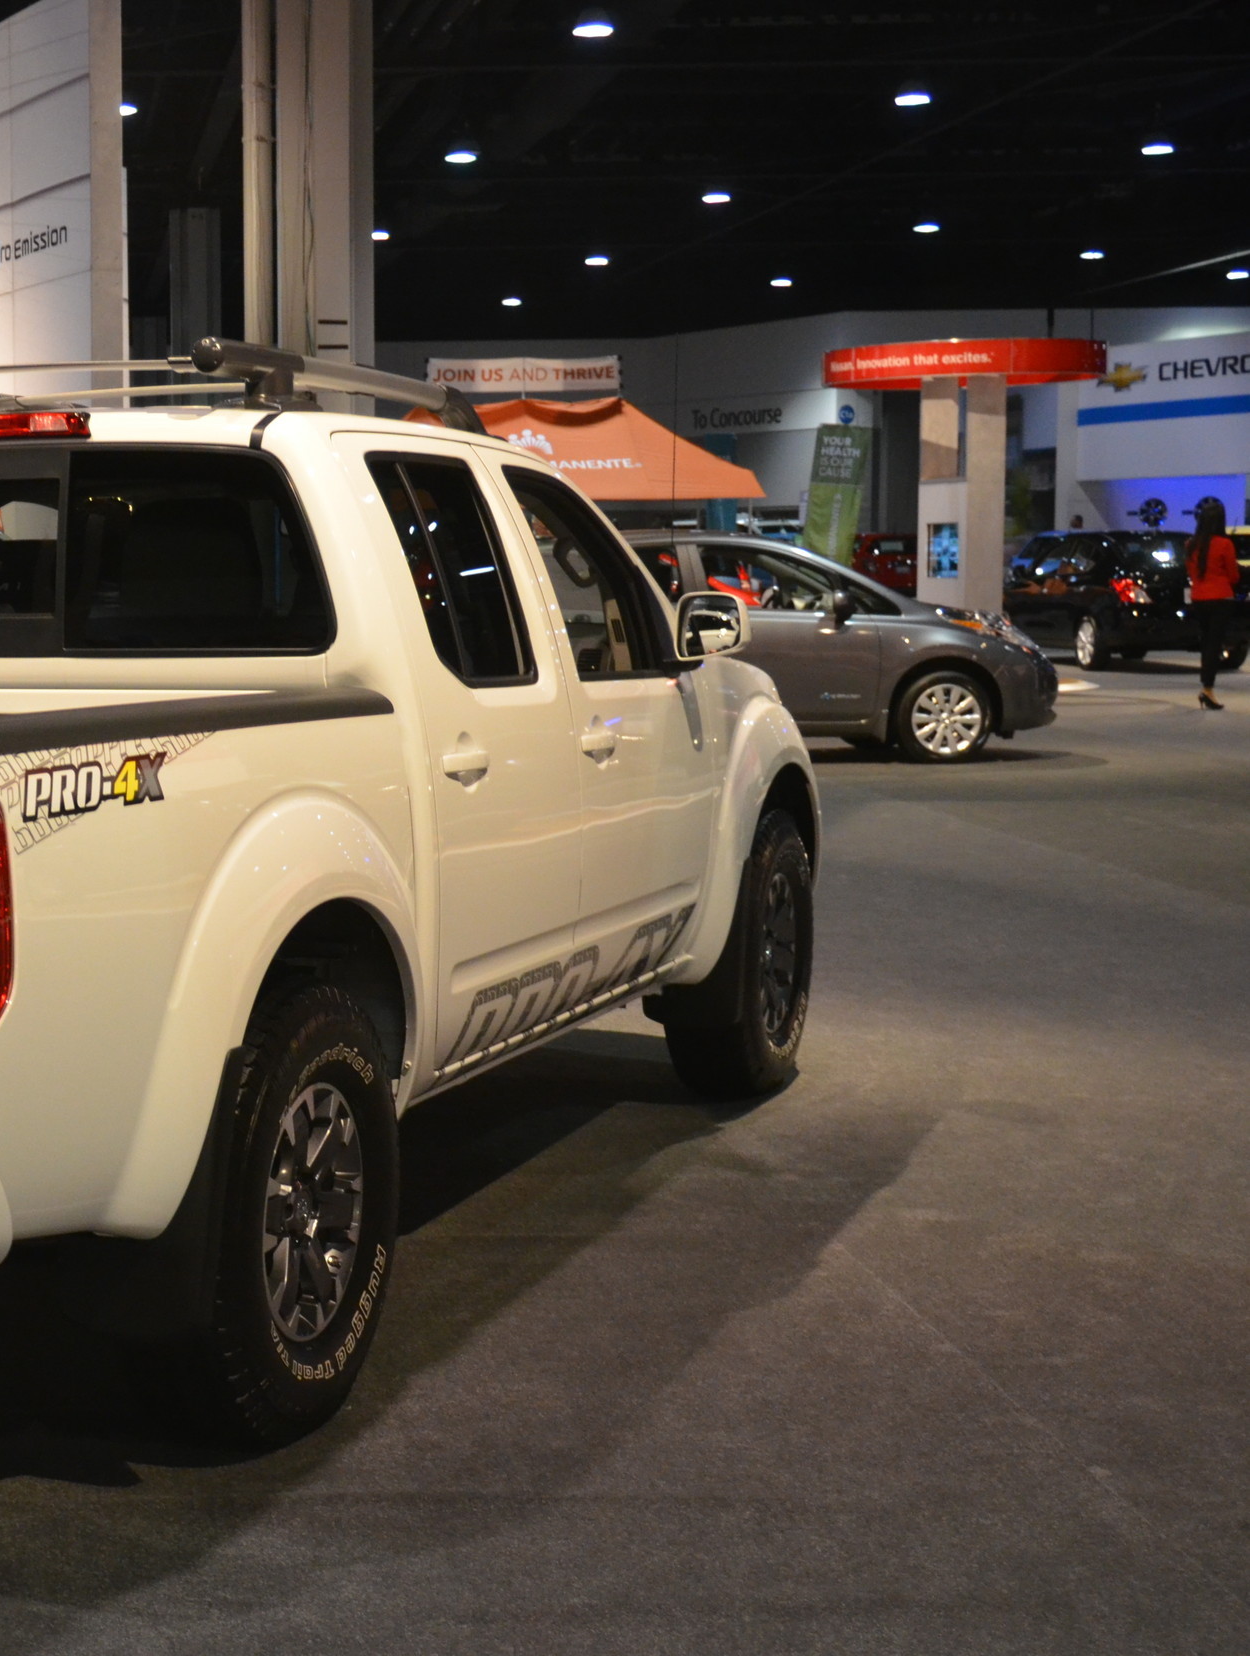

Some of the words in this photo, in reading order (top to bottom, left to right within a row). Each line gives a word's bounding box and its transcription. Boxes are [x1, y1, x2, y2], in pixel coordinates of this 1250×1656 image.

[13, 225, 68, 260] Emission
[856, 355, 910, 370] Innovation
[913, 353, 938, 366] that
[433, 369, 475, 383] JOIN
[480, 368, 503, 382] US
[508, 367, 548, 382] AND
[552, 365, 616, 381] THRIVE
[691, 409, 707, 430] To
[710, 407, 782, 428] Concourse
[823, 436, 852, 446] YOUR
[23, 752, 167, 822] PRO-4X
[335, 1244, 386, 1371] Rugged
[291, 1360, 335, 1380] Trail
